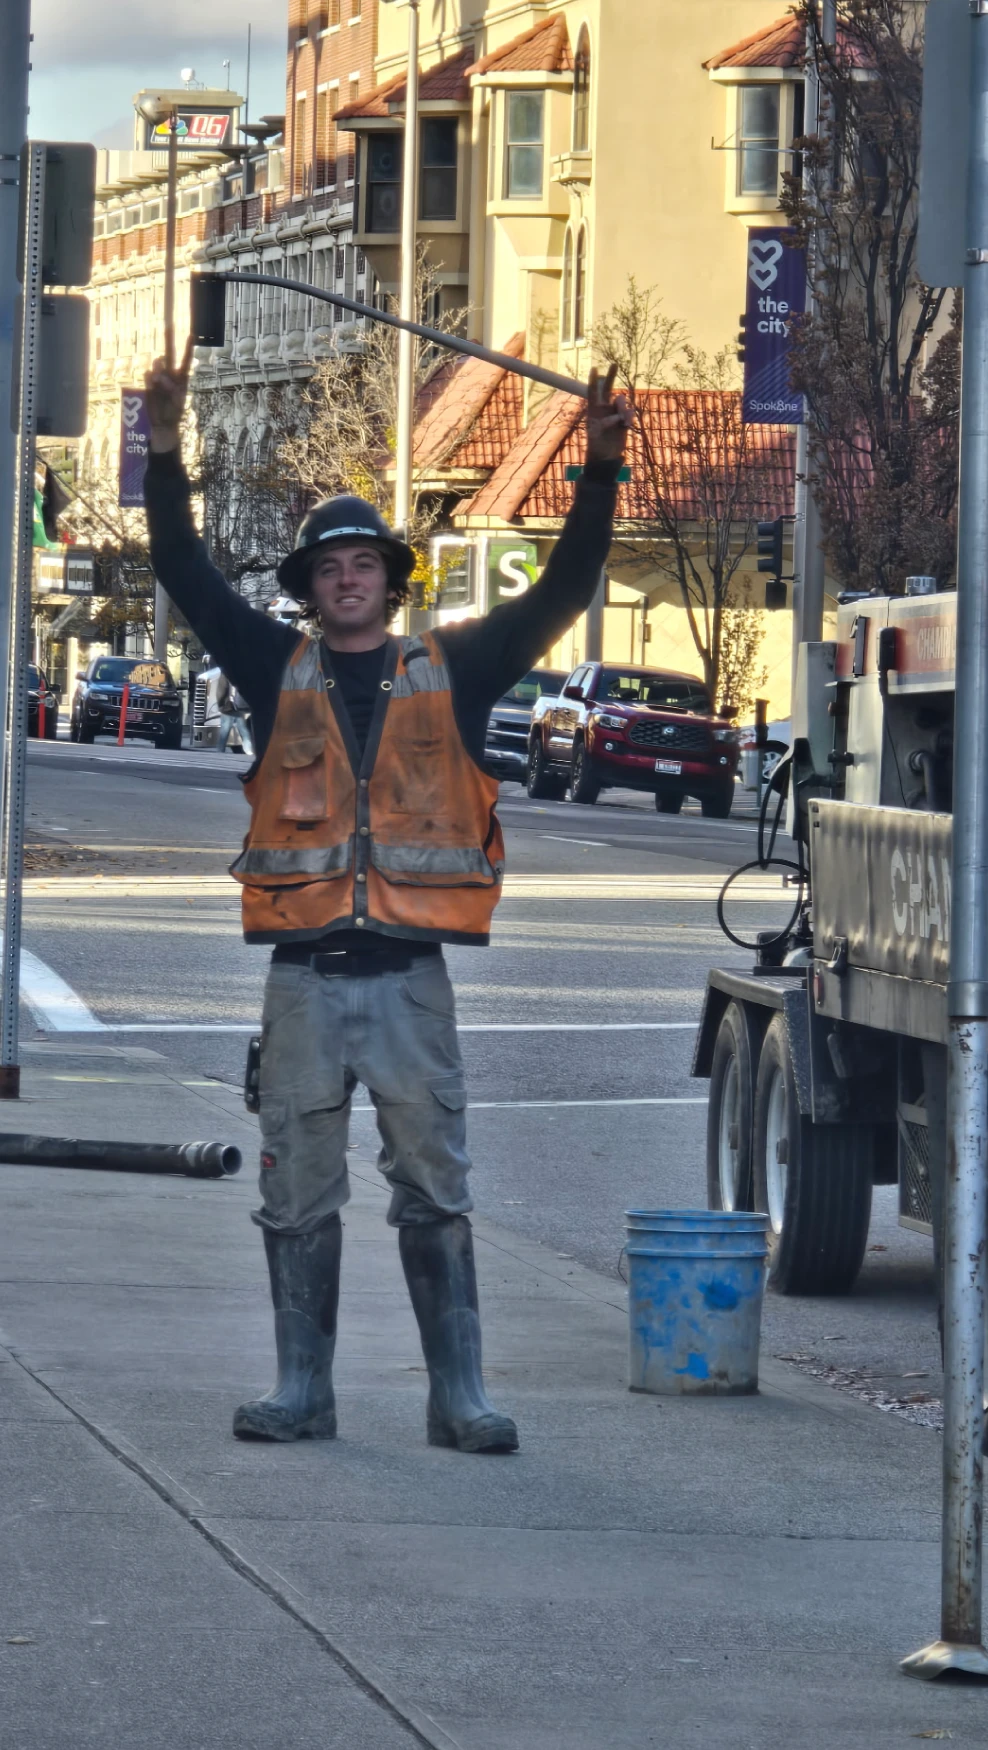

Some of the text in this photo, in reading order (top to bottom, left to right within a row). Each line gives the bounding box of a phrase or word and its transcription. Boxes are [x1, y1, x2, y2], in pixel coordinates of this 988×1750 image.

[191, 115, 224, 136] Q6
[757, 295, 789, 314] the
[757, 315, 791, 338] city
[126, 430, 146, 442] the
[126, 443, 148, 456] city
[499, 550, 529, 597] S
